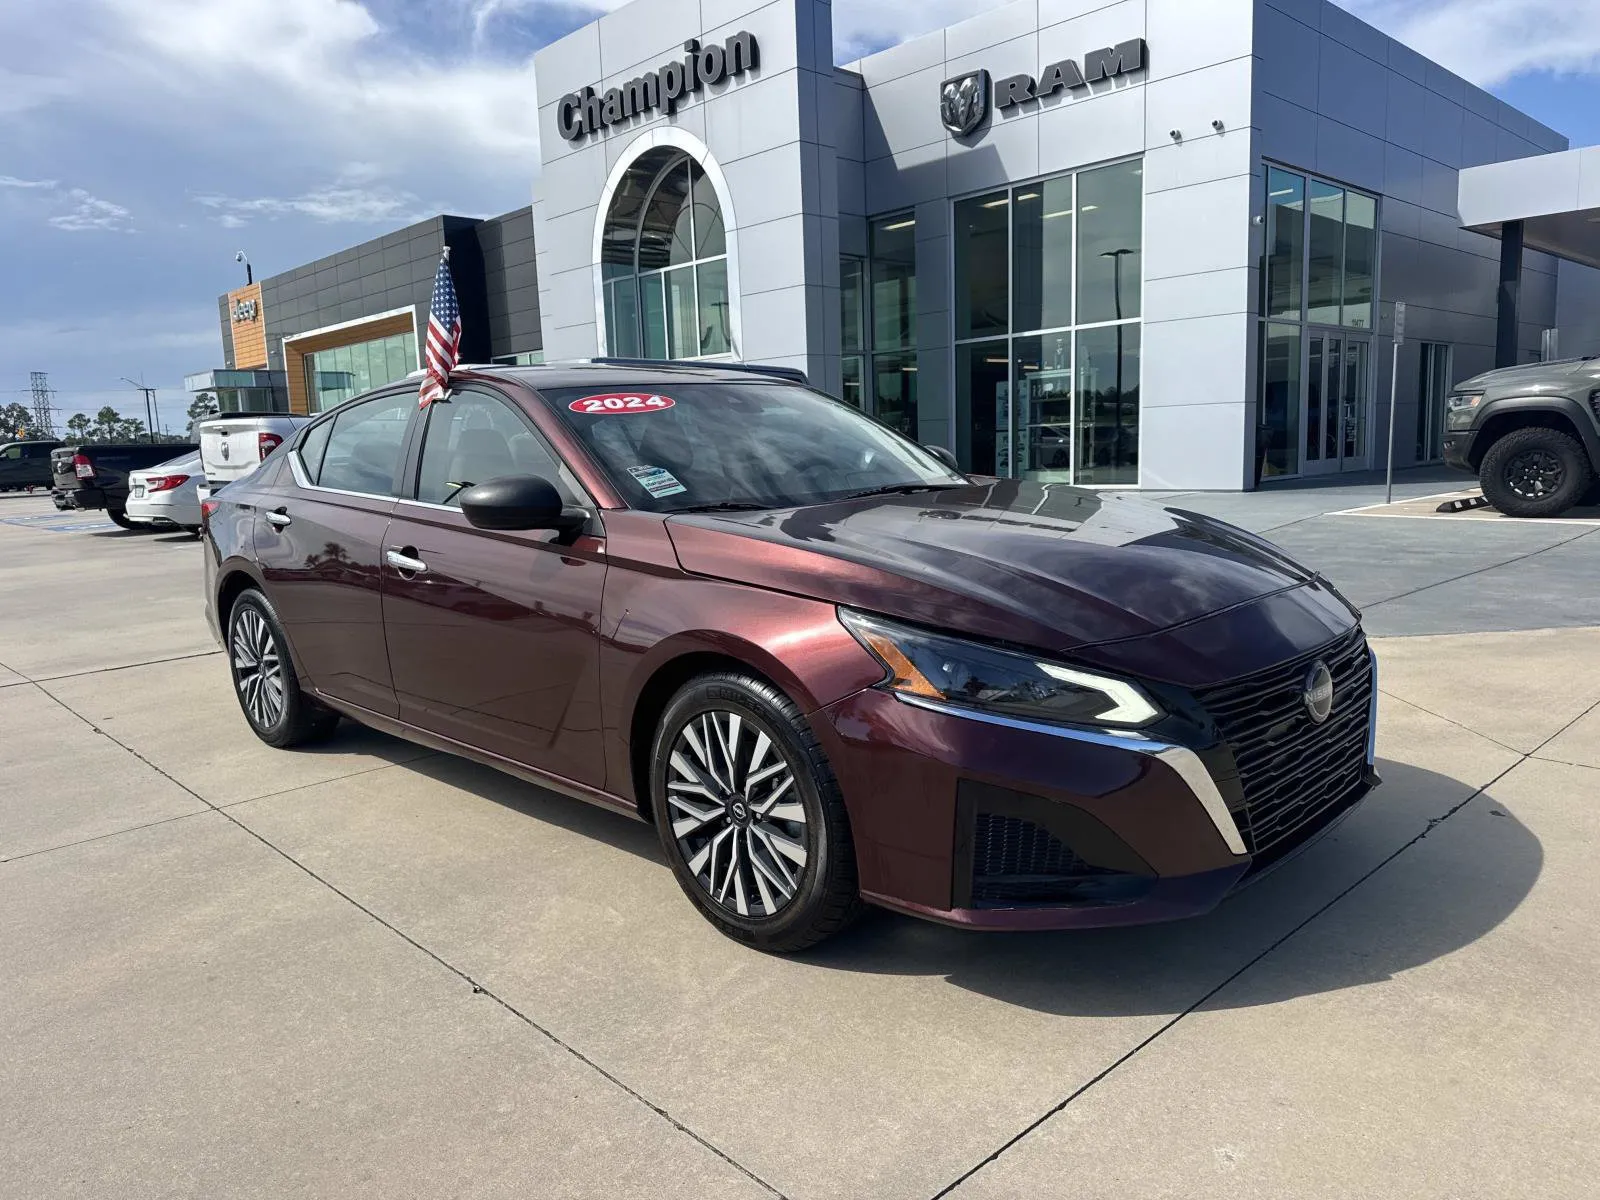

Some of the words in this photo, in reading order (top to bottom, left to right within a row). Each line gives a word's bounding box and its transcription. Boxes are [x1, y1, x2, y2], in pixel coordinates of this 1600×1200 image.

[557, 31, 759, 140] Champion
[994, 38, 1149, 108] RAM
[233, 299, 256, 320] Jeep
[583, 395, 665, 411] 2024
